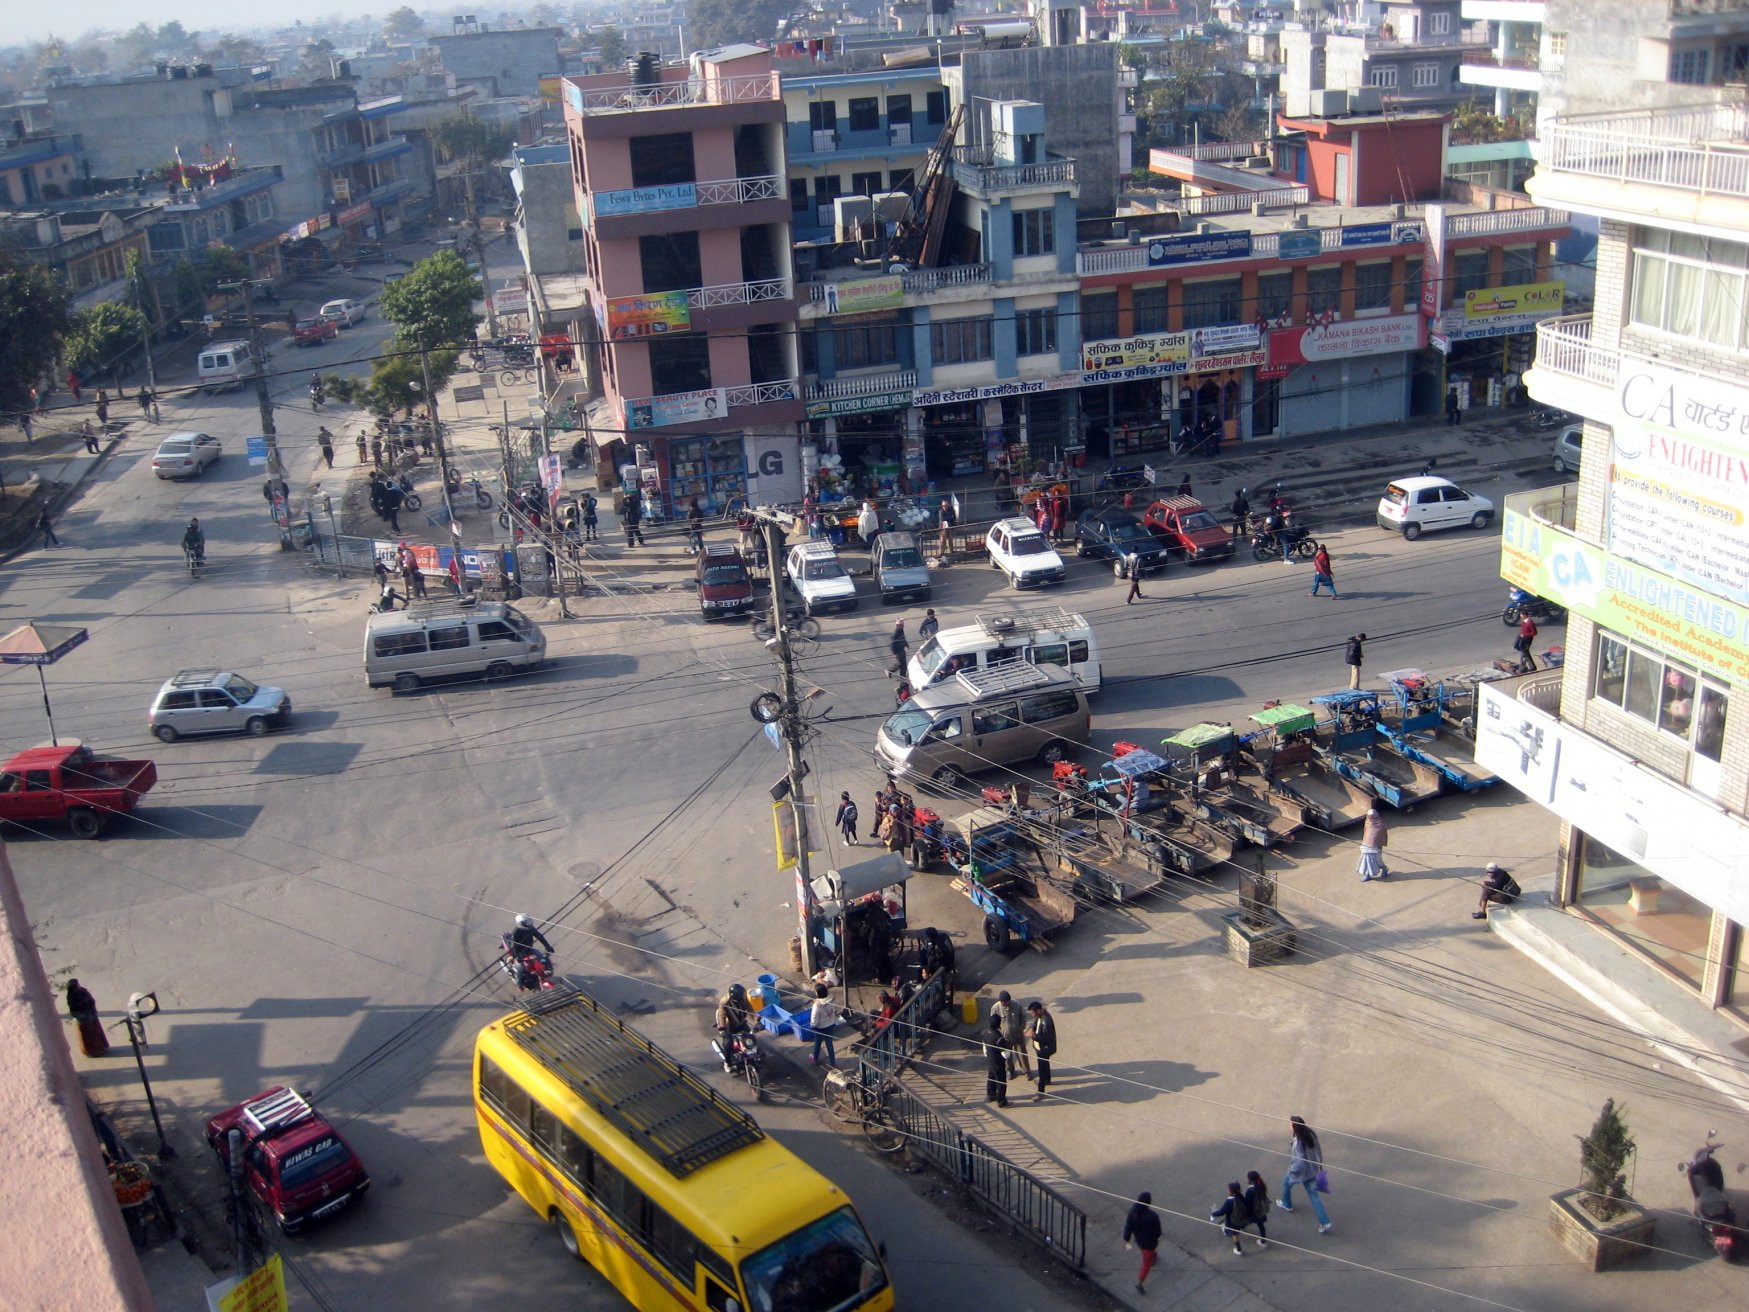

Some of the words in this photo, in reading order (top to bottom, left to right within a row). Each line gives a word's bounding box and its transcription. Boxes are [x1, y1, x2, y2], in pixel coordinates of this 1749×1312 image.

[609, 193, 632, 205] Fewa
[677, 186, 695, 198] Ltd.
[1318, 329, 1350, 341] KAMANA
[1351, 325, 1380, 337] BIKASH
[1380, 323, 1401, 333] BANK
[691, 389, 719, 400] PLACE
[831, 399, 862, 413] KITCHEN
[862, 395, 889, 407] CORNER
[1624, 477, 1650, 492] provide
[1652, 484, 1663, 497] the
[1667, 488, 1700, 512] following
[1702, 503, 1734, 521] courses
[1552, 550, 1593, 587] CA
[1604, 559, 1737, 639] ENLIGHTENED
[1609, 593, 1681, 634] Accredited
[1635, 619, 1657, 638] The
[1660, 631, 1715, 663] Institute
[1717, 659, 1734, 670] of
